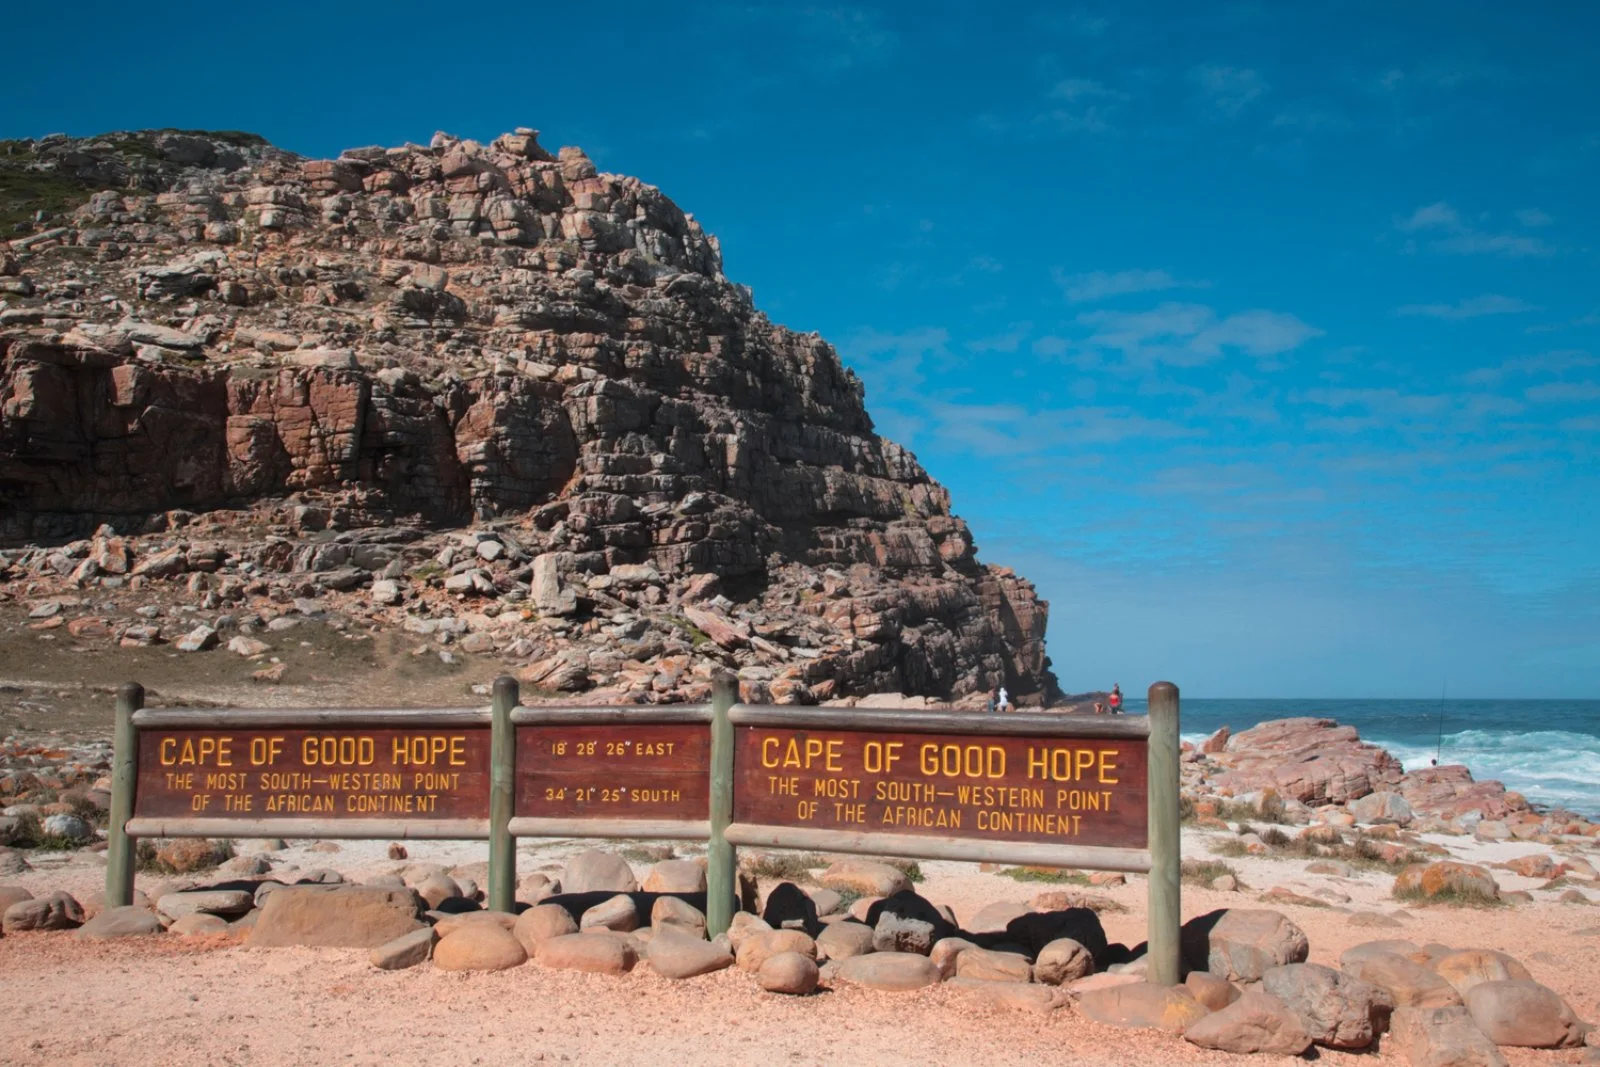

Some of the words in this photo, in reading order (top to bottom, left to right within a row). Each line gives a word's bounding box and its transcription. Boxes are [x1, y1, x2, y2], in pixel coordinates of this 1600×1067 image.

[160, 738, 233, 766] CAPE
[250, 738, 285, 766] OF
[302, 736, 374, 765] GOOD
[392, 736, 467, 766] HOPE
[635, 743, 675, 756] EAST
[762, 737, 844, 772] CAPE
[864, 742, 903, 774] OF
[919, 743, 1006, 779] GOOD
[1027, 747, 1120, 784] HOPE
[166, 773, 193, 790] THE
[207, 773, 247, 790] MOST
[415, 773, 460, 790] POINT
[192, 795, 210, 812] OF
[225, 795, 252, 812] THE
[265, 795, 334, 812] AFRICAN
[347, 794, 439, 813] CONTINENT
[631, 789, 680, 802] SOUTH
[768, 776, 799, 796] THE
[814, 779, 861, 798] MOST
[1057, 790, 1113, 812] POINT
[798, 801, 818, 820] OF
[835, 803, 866, 823] THE
[882, 807, 961, 829] AFRICAN
[977, 811, 1082, 836] CONTINENT
